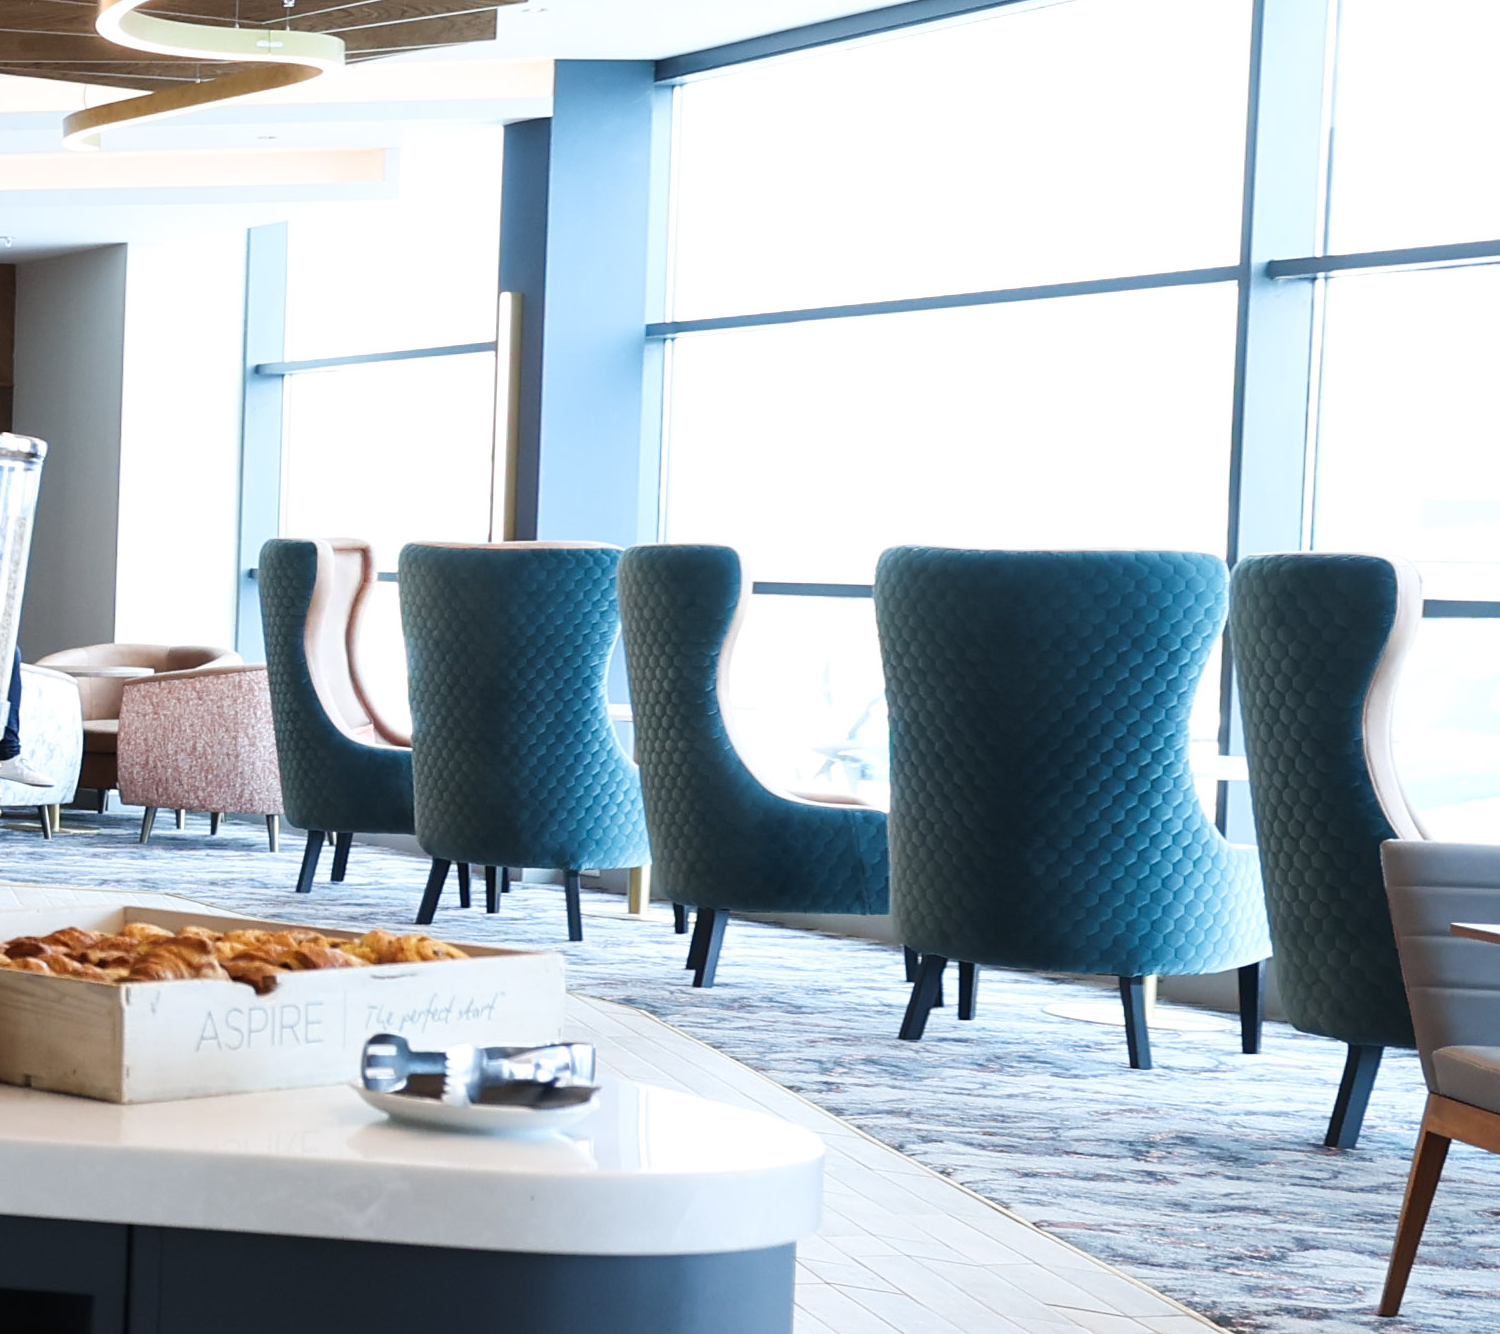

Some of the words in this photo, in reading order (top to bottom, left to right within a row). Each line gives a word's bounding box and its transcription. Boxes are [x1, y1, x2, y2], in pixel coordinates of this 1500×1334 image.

[194, 1001, 326, 1053] ASPIRE
[365, 1004, 394, 1031] The
[399, 993, 454, 1033] perfect
[457, 993, 499, 1021] start
